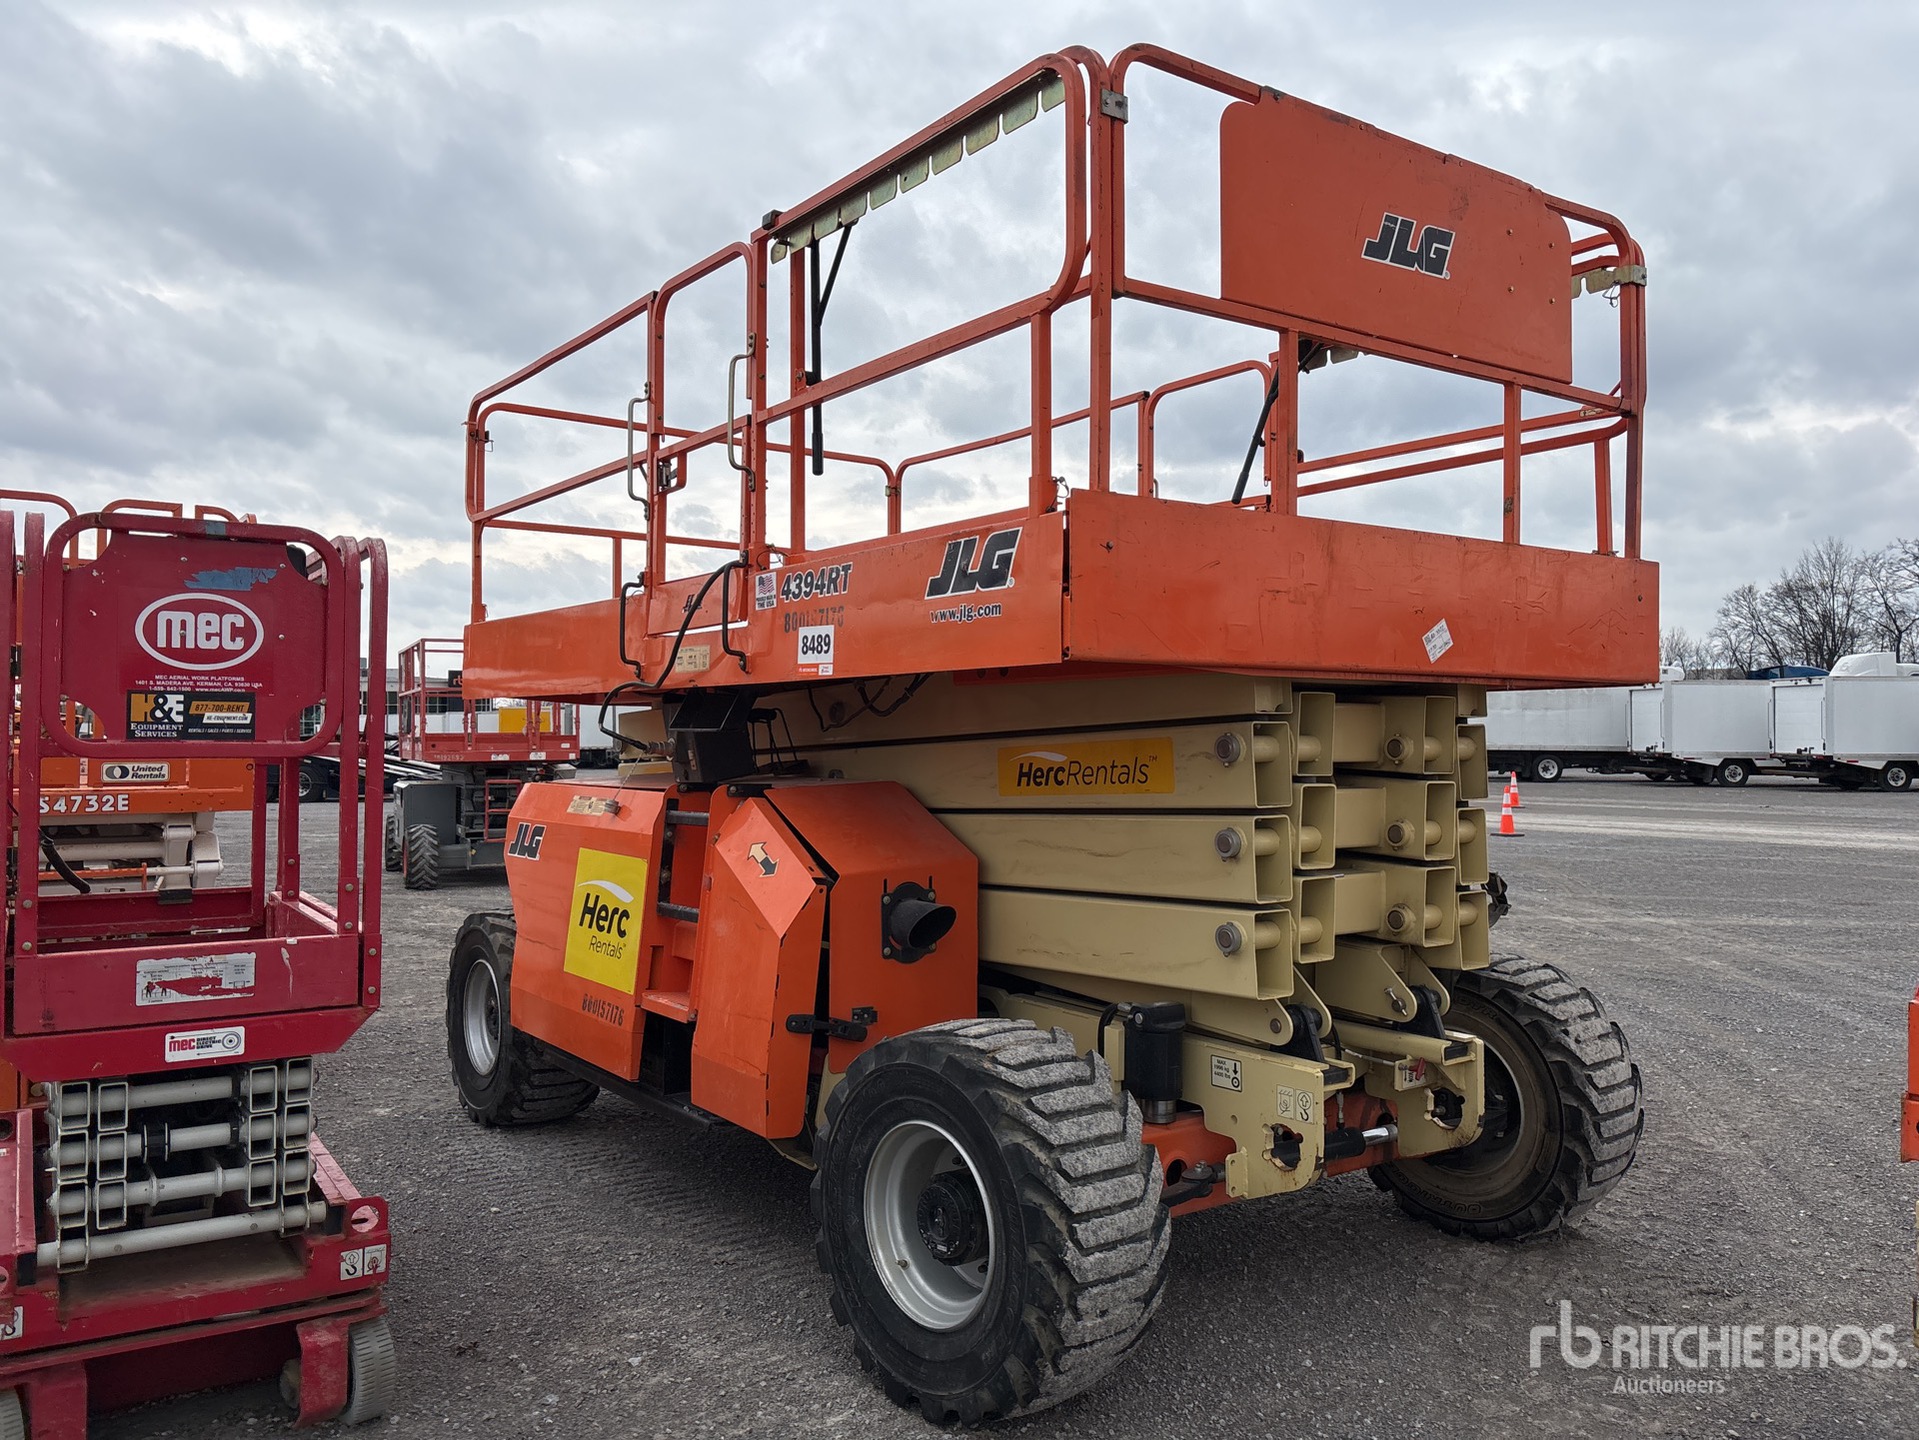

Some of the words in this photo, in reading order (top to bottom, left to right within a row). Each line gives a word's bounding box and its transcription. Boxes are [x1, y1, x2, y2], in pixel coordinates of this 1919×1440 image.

[1362, 212, 1454, 279] JLG
[926, 527, 1023, 599] JLG
[780, 562, 853, 602] 4394RT
[930, 604, 1002, 624] www.jlg.com
[801, 633, 831, 655] 8489
[130, 693, 185, 722] H&E
[131, 765, 163, 773] United
[131, 772, 166, 780] Rentals
[508, 822, 546, 860] JLG
[579, 892, 630, 938] Herc
[589, 935, 623, 960] Rentals
[169, 1039, 195, 1052] mec
